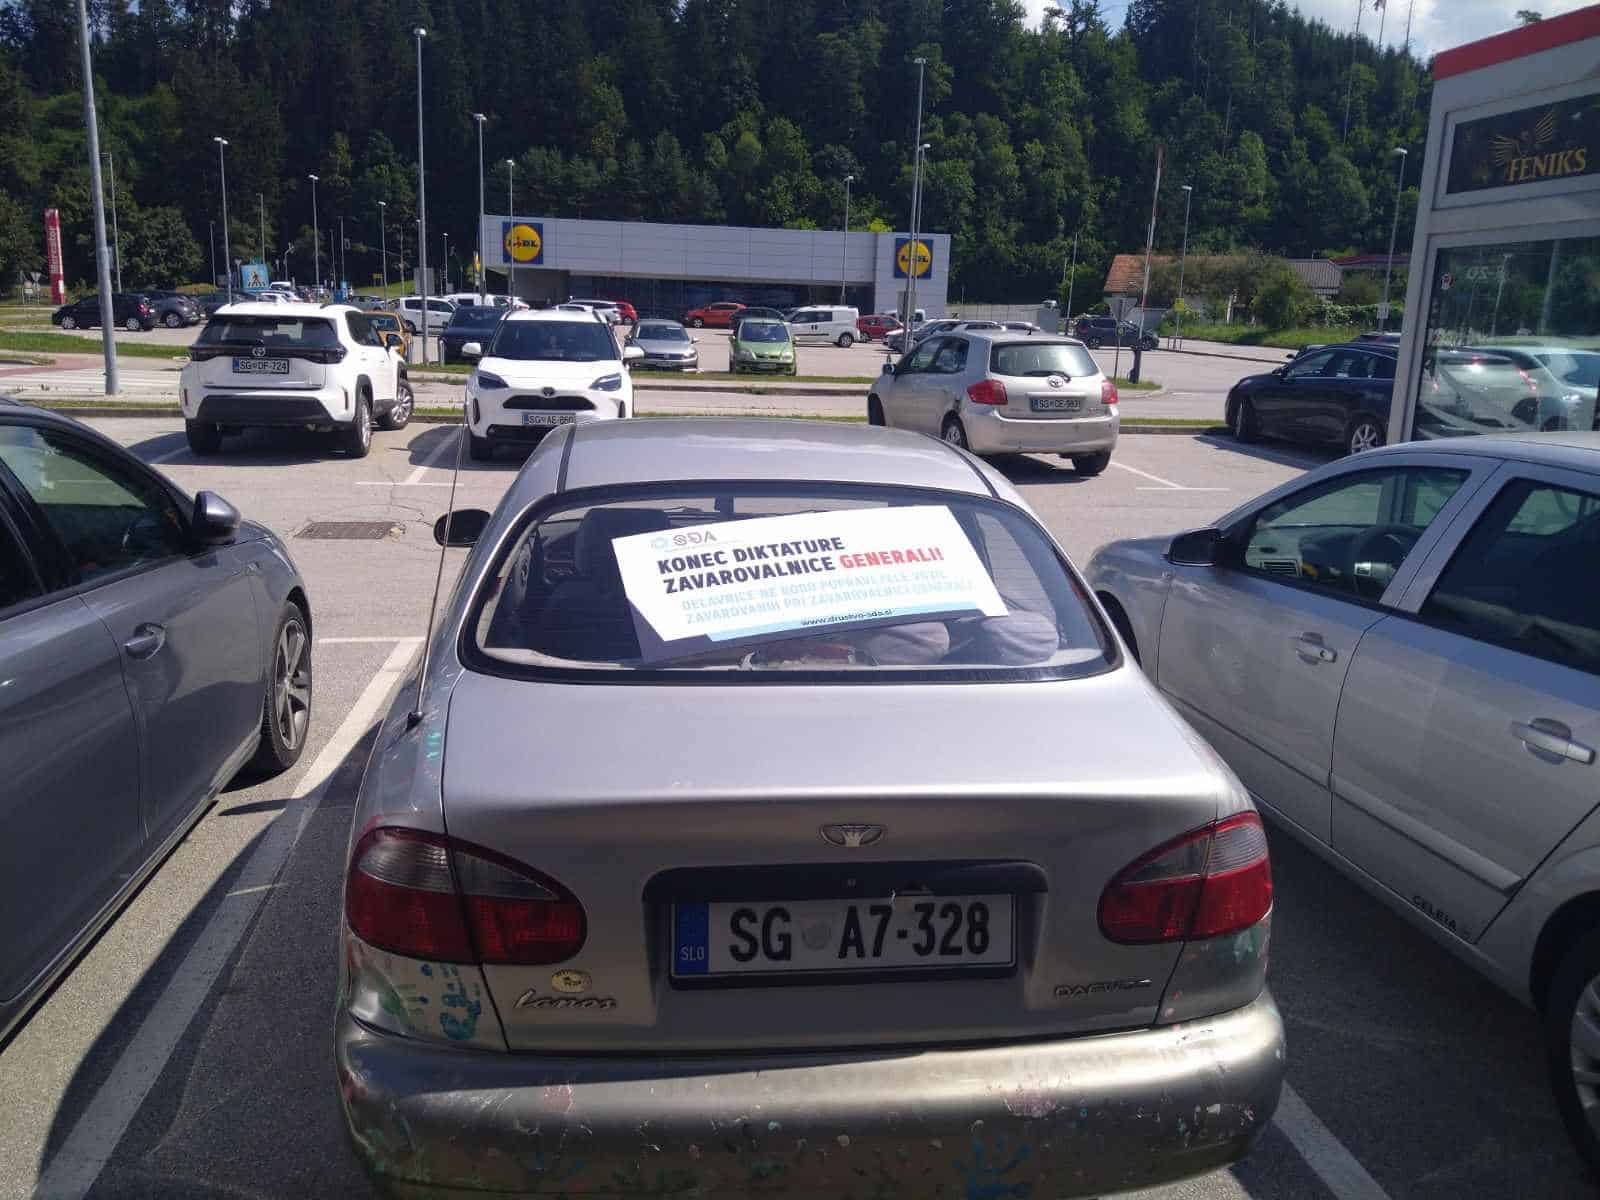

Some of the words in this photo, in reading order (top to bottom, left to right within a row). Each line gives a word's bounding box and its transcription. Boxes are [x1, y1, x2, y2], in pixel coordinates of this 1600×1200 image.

[1507, 149, 1586, 182] FENIKS
[240, 360, 251, 370] SG
[529, 415, 541, 424] SG
[657, 550, 729, 575] KONEC
[731, 537, 845, 563] DIKTATURE
[662, 556, 837, 595] ZAVAROVALNICE
[728, 906, 793, 963] SG
[837, 901, 990, 960] A7-328
[680, 946, 705, 961] SLO
